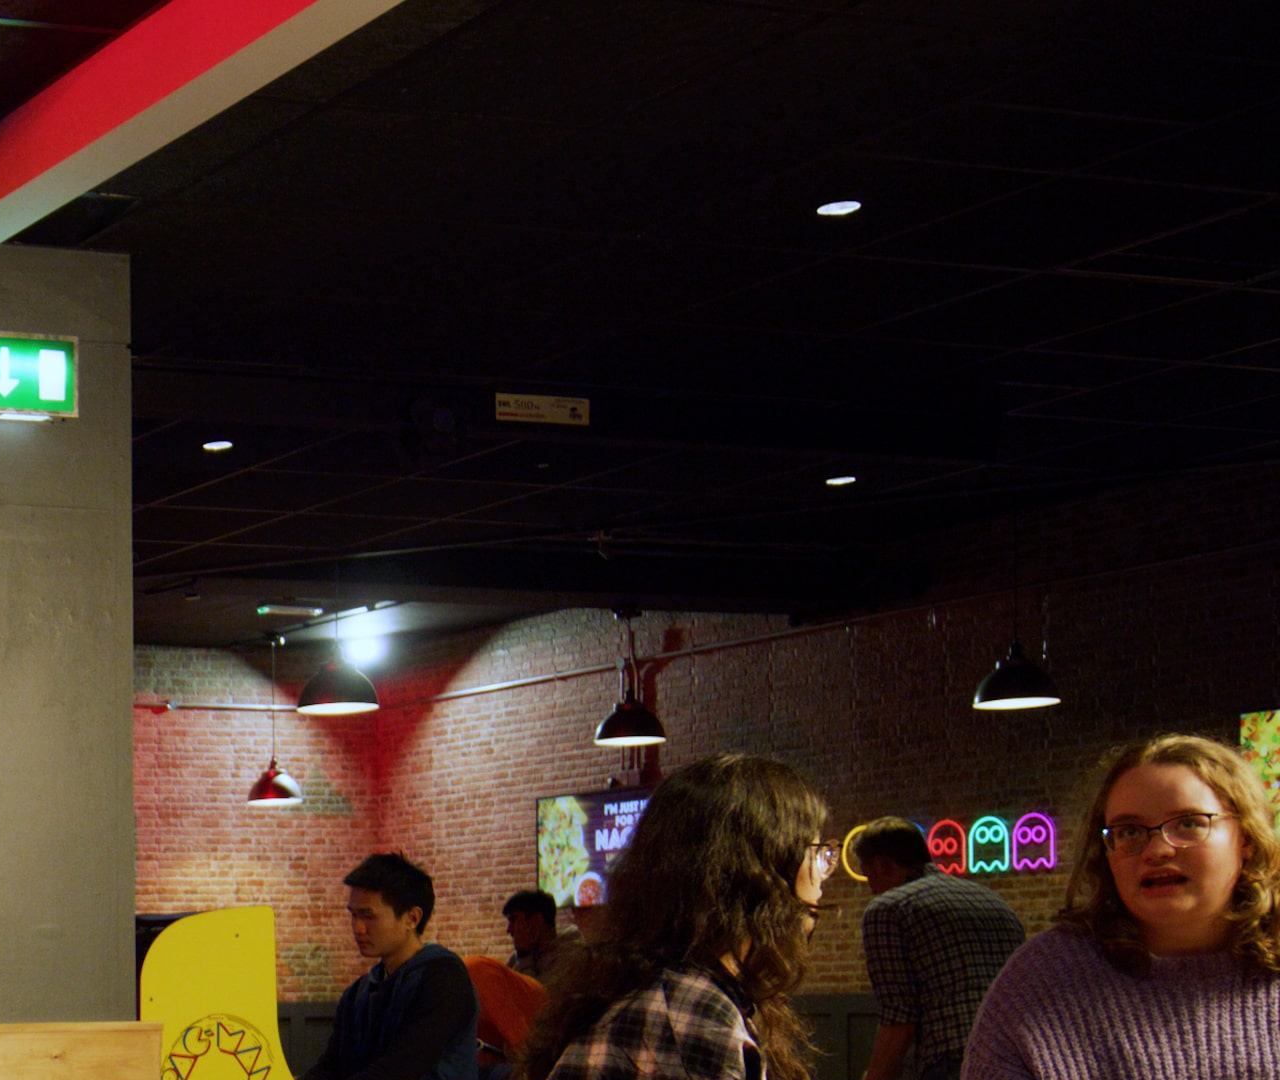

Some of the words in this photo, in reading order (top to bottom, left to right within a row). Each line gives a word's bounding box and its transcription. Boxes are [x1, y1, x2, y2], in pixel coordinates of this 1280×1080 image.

[514, 398, 534, 410] 500
[603, 801, 618, 816] I'M
[619, 799, 639, 814] JUST
[614, 813, 634, 827] FOR
